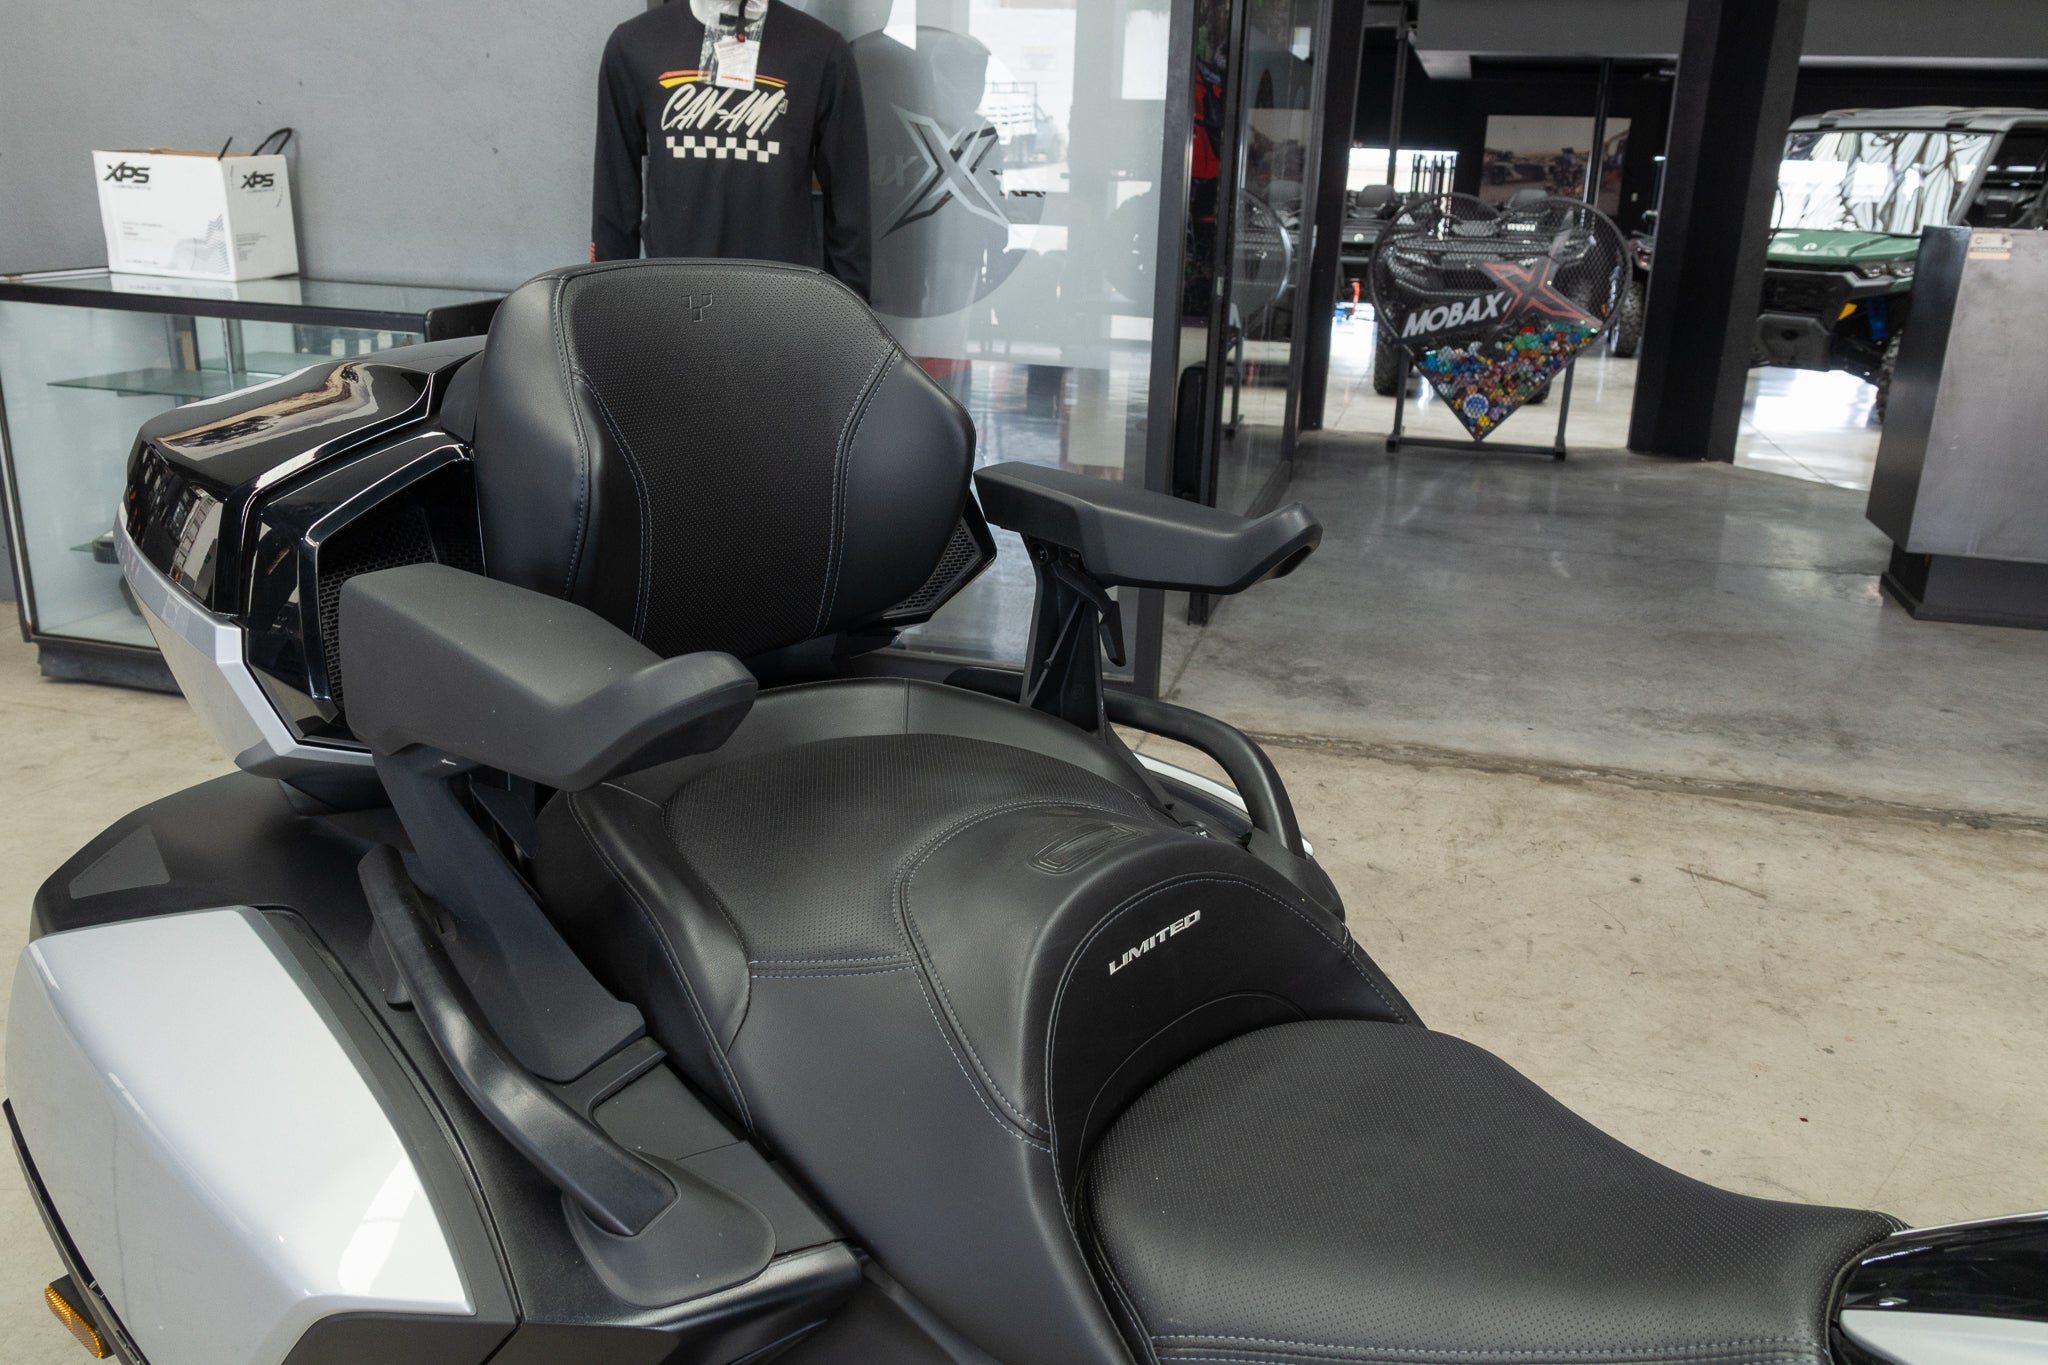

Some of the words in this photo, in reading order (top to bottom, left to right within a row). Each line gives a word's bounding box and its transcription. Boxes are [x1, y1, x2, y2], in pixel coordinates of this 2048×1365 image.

[661, 83, 786, 138] CAN-AM
[104, 161, 151, 183] XPS
[241, 171, 274, 188] XPS
[1401, 291, 1505, 338] MOBAX
[1109, 909, 1201, 975] LIMITED
